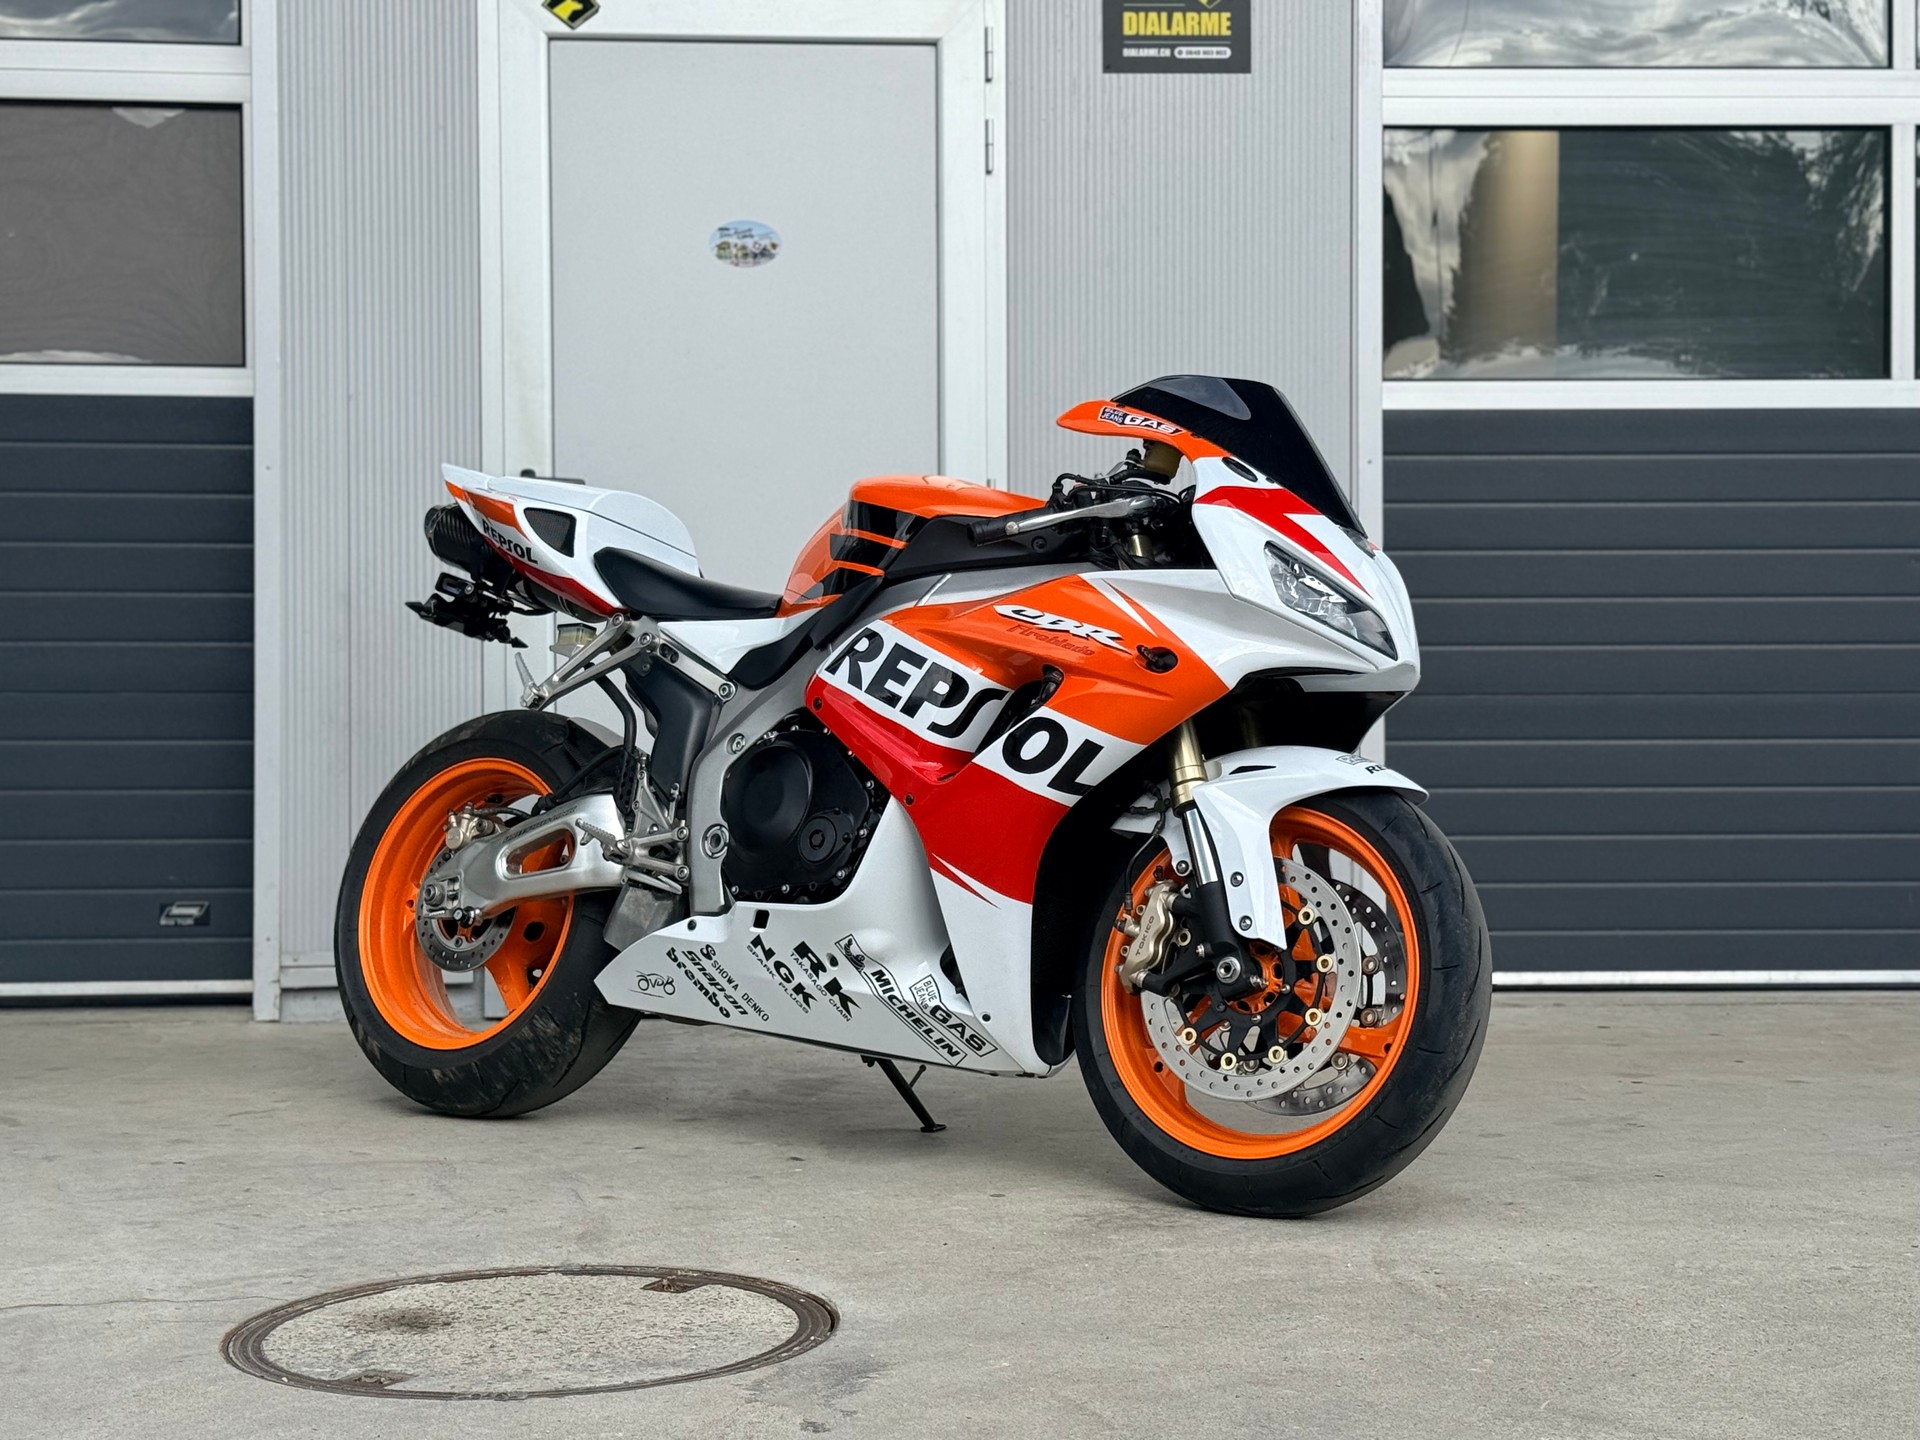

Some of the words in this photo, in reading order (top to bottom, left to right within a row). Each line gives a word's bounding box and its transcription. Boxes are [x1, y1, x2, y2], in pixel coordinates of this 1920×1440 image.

[1123, 11, 1232, 36] DIALARME
[1101, 412, 1124, 424] JEANS
[1123, 414, 1177, 434] GAS
[482, 519, 538, 565] REPSOL
[826, 627, 1104, 796] REPSOL
[1135, 915, 1155, 956] TOKICO
[665, 947, 731, 1019] brembo
[711, 960, 739, 991] SHOWA
[741, 992, 770, 1022] DENKO
[746, 944, 777, 979] SPARK
[778, 981, 810, 1014] PLUGS
[750, 934, 818, 1010] NGK
[790, 951, 828, 997] TAKASAGO
[828, 998, 851, 1022] CHAIN
[793, 940, 862, 1019] RK
[914, 985, 929, 1010] JEANS
[923, 980, 938, 1002] BLUE
[870, 969, 961, 1058] MICHELIN
[929, 1004, 987, 1052] GAS
